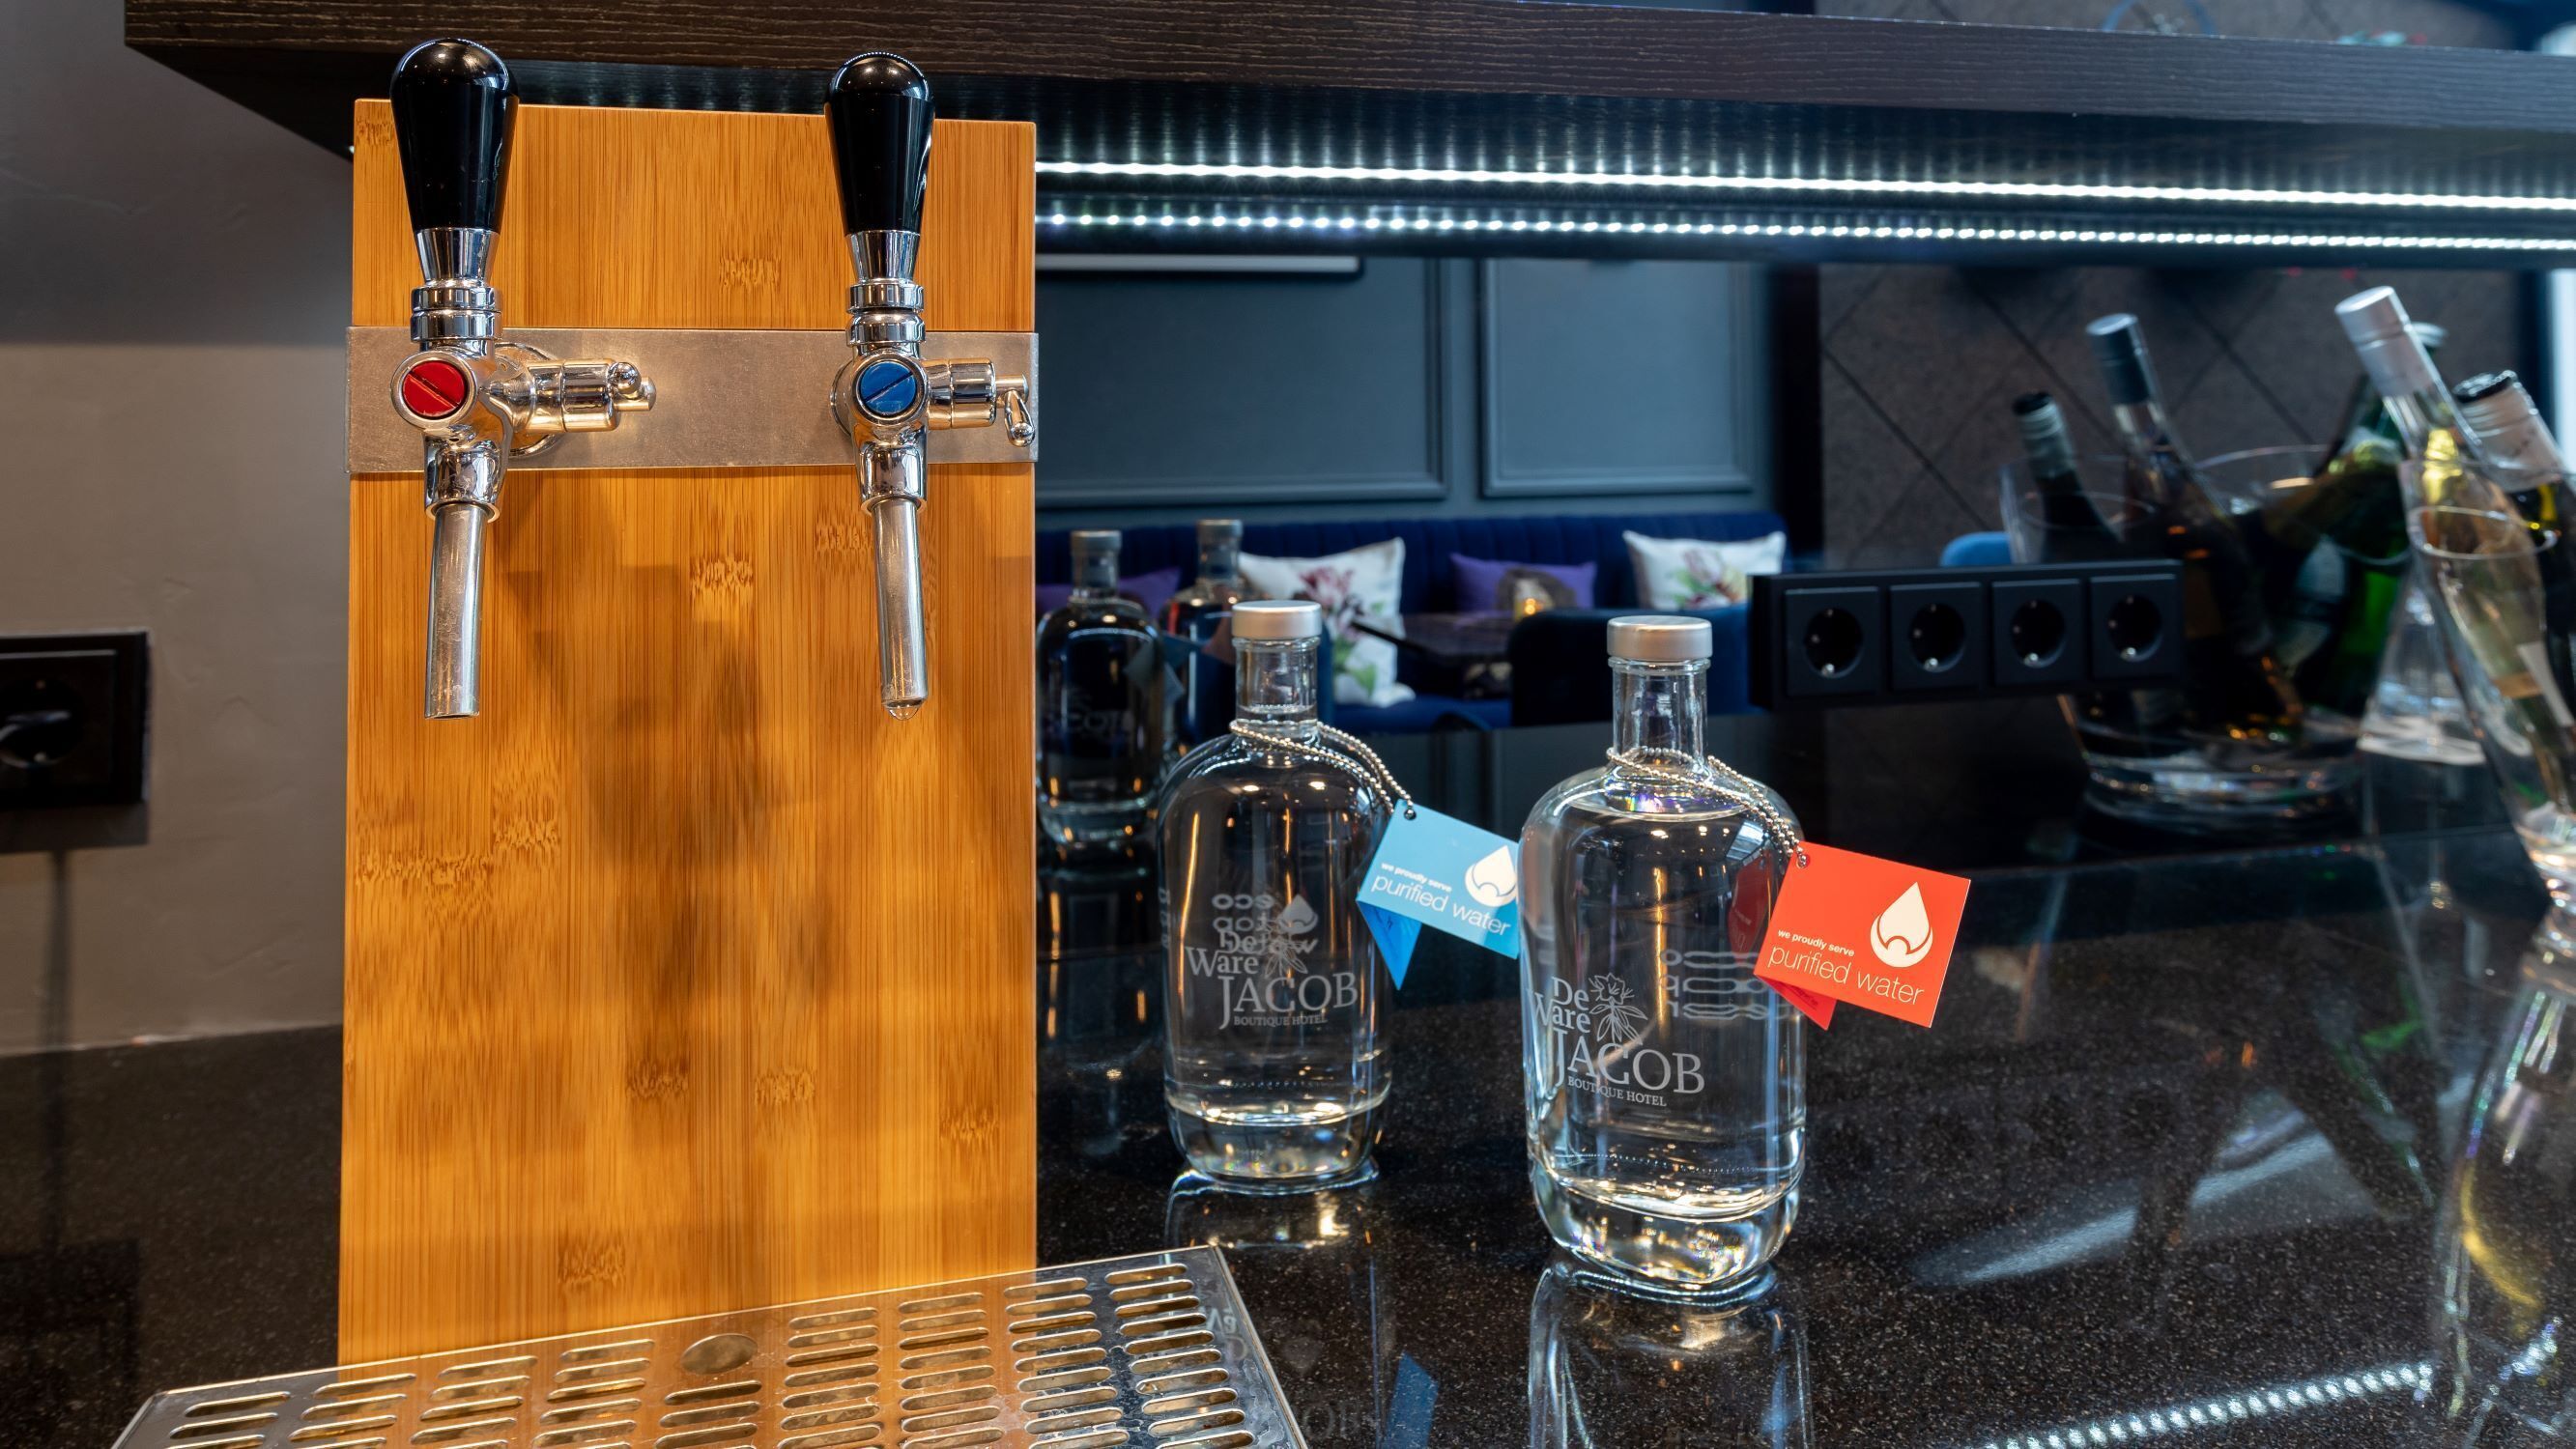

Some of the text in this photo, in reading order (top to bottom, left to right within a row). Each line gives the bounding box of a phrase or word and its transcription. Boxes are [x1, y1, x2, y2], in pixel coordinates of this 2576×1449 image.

[1381, 863, 1452, 893] we proudly serve
[1371, 875, 1511, 935] purified water
[1219, 930, 1257, 954] De
[1777, 929, 1855, 957] we proudly serve
[1185, 946, 1260, 978] Ware
[1767, 947, 1851, 984] purified
[1857, 970, 1925, 1005] water
[1217, 972, 1359, 1030] JACOB
[1526, 987, 1591, 1034] Ware
[1551, 977, 1590, 1011] De
[1234, 1014, 1328, 1027] BOUTIQUE HOTEL
[1555, 1027, 1705, 1094] JACOB
[1626, 1091, 1667, 1107] HOTEL
